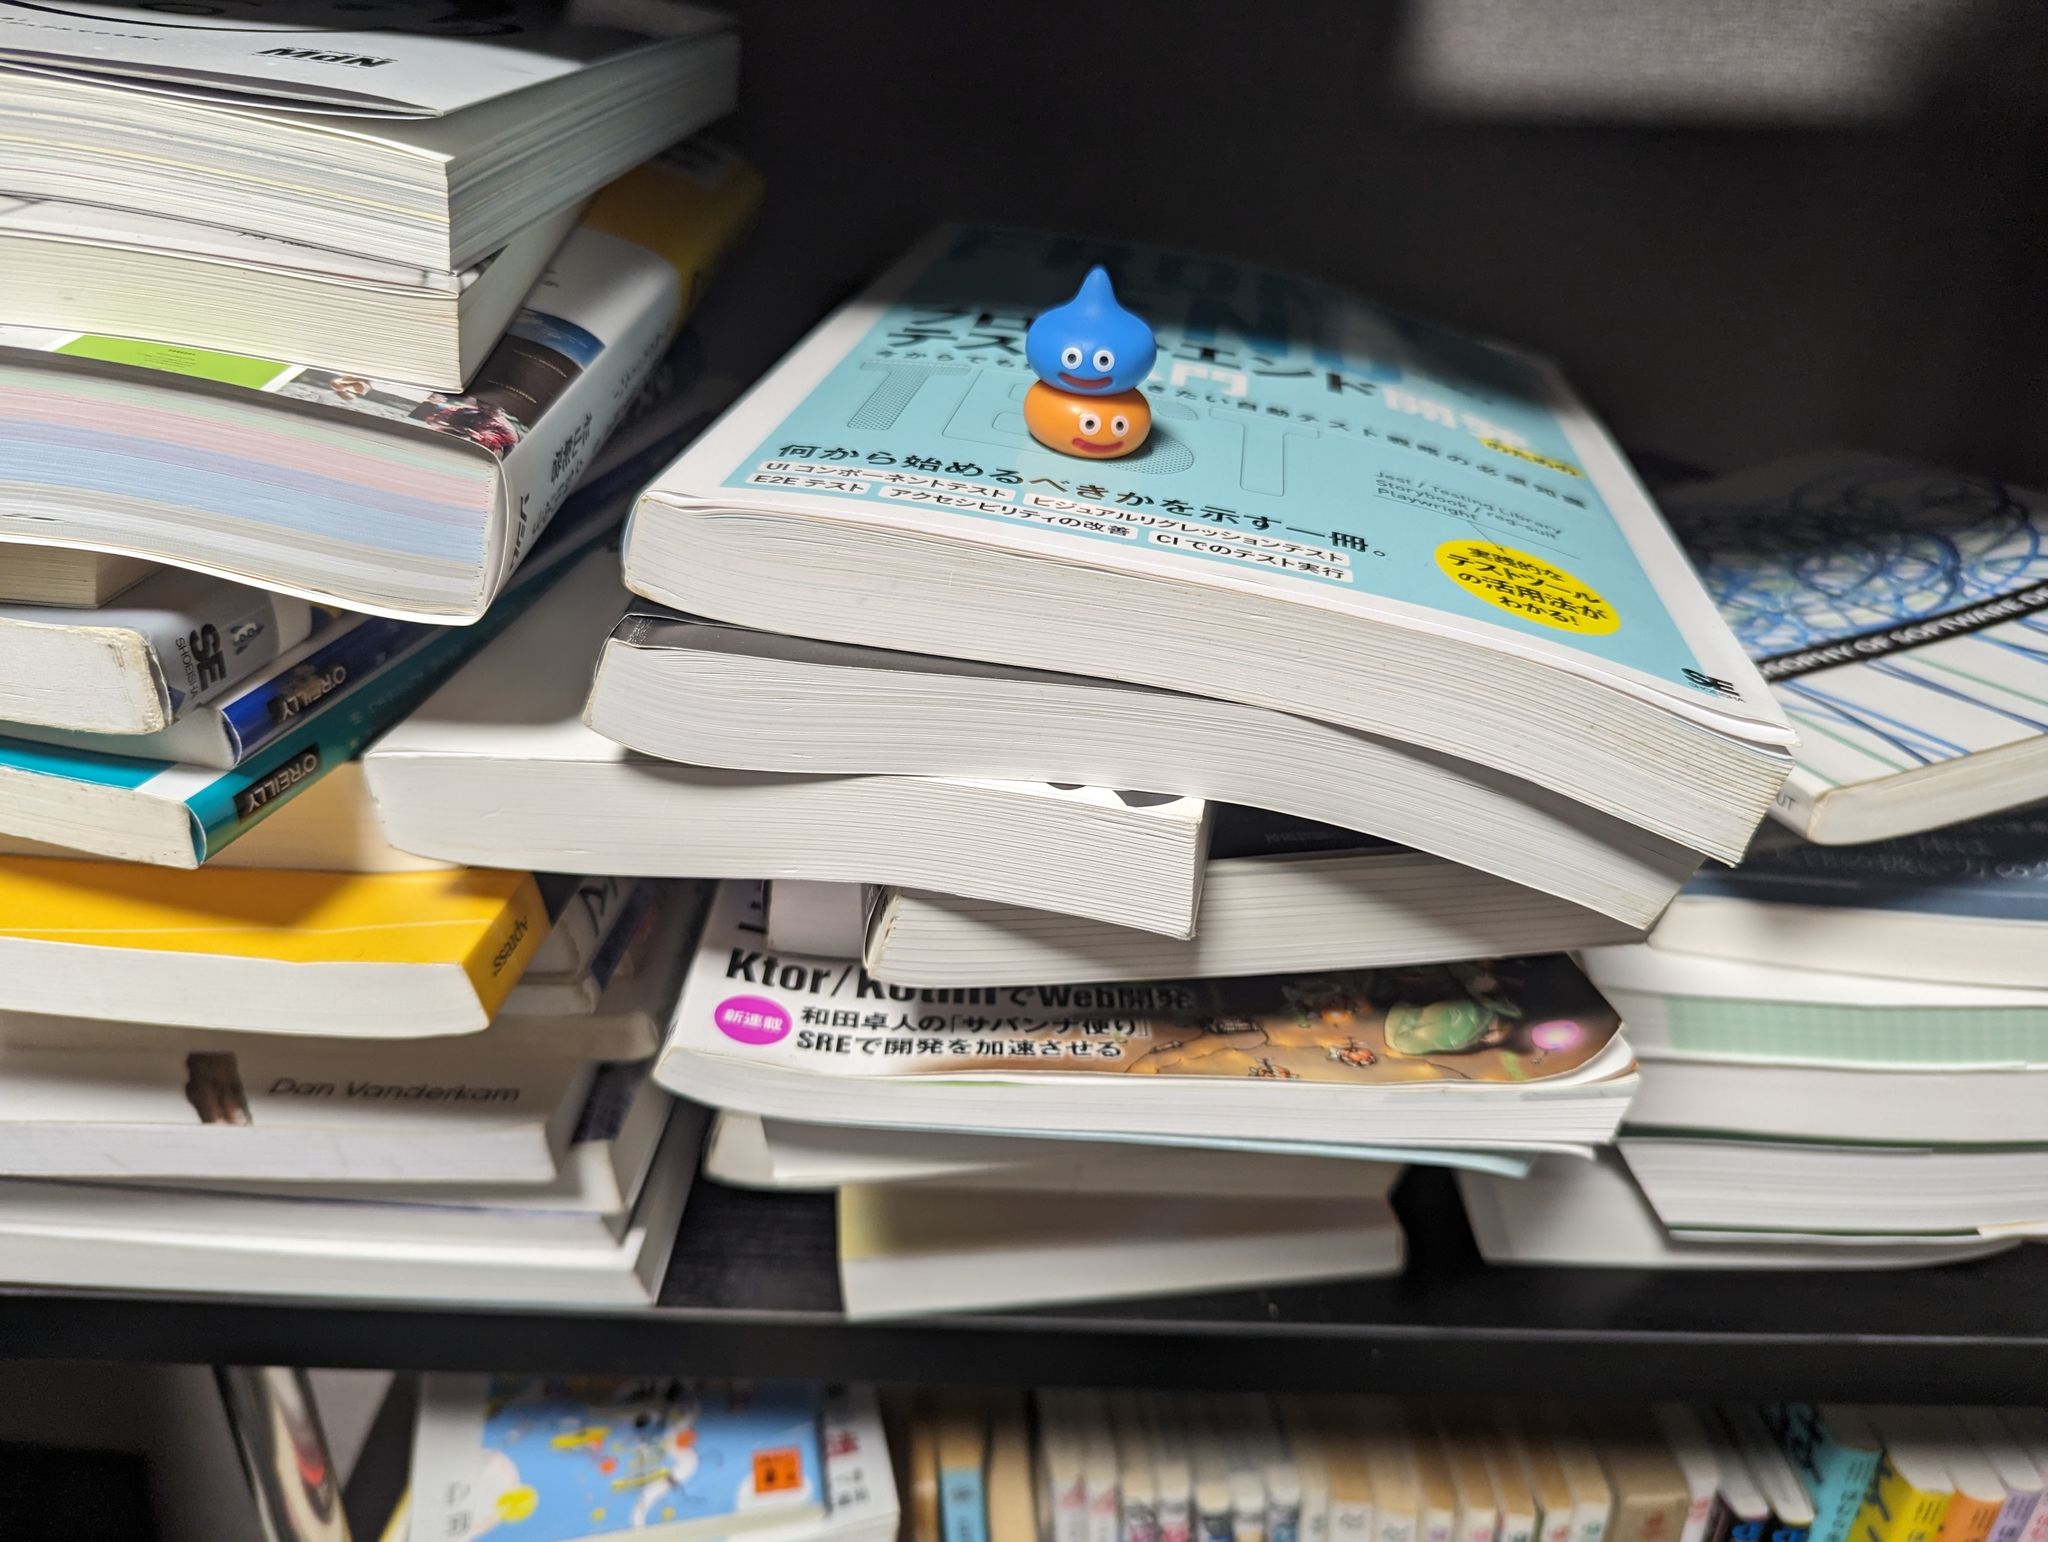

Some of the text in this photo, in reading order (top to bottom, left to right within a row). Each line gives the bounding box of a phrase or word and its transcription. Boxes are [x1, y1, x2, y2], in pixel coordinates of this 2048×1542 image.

[257, 48, 393, 67] MdN
[778, 443, 1386, 557] 何から始めるべきかを示す一冊。
[889, 489, 1130, 537] アクセシビリティの改善
[1377, 487, 1477, 521] Playwright
[1033, 496, 1345, 563] ビジュアルリグレッションテスト
[1446, 553, 1602, 605] テストツール
[1457, 572, 1609, 620] の活用法が
[1890, 601, 2025, 644] SOFTWARE
[175, 636, 199, 698] SHOEISHA
[189, 623, 227, 692] SE
[248, 752, 318, 813] O'REILLY
[797, 1029, 1122, 1058] SREで開発を加速させる
[267, 1077, 521, 1102] Dan Vanderkam
